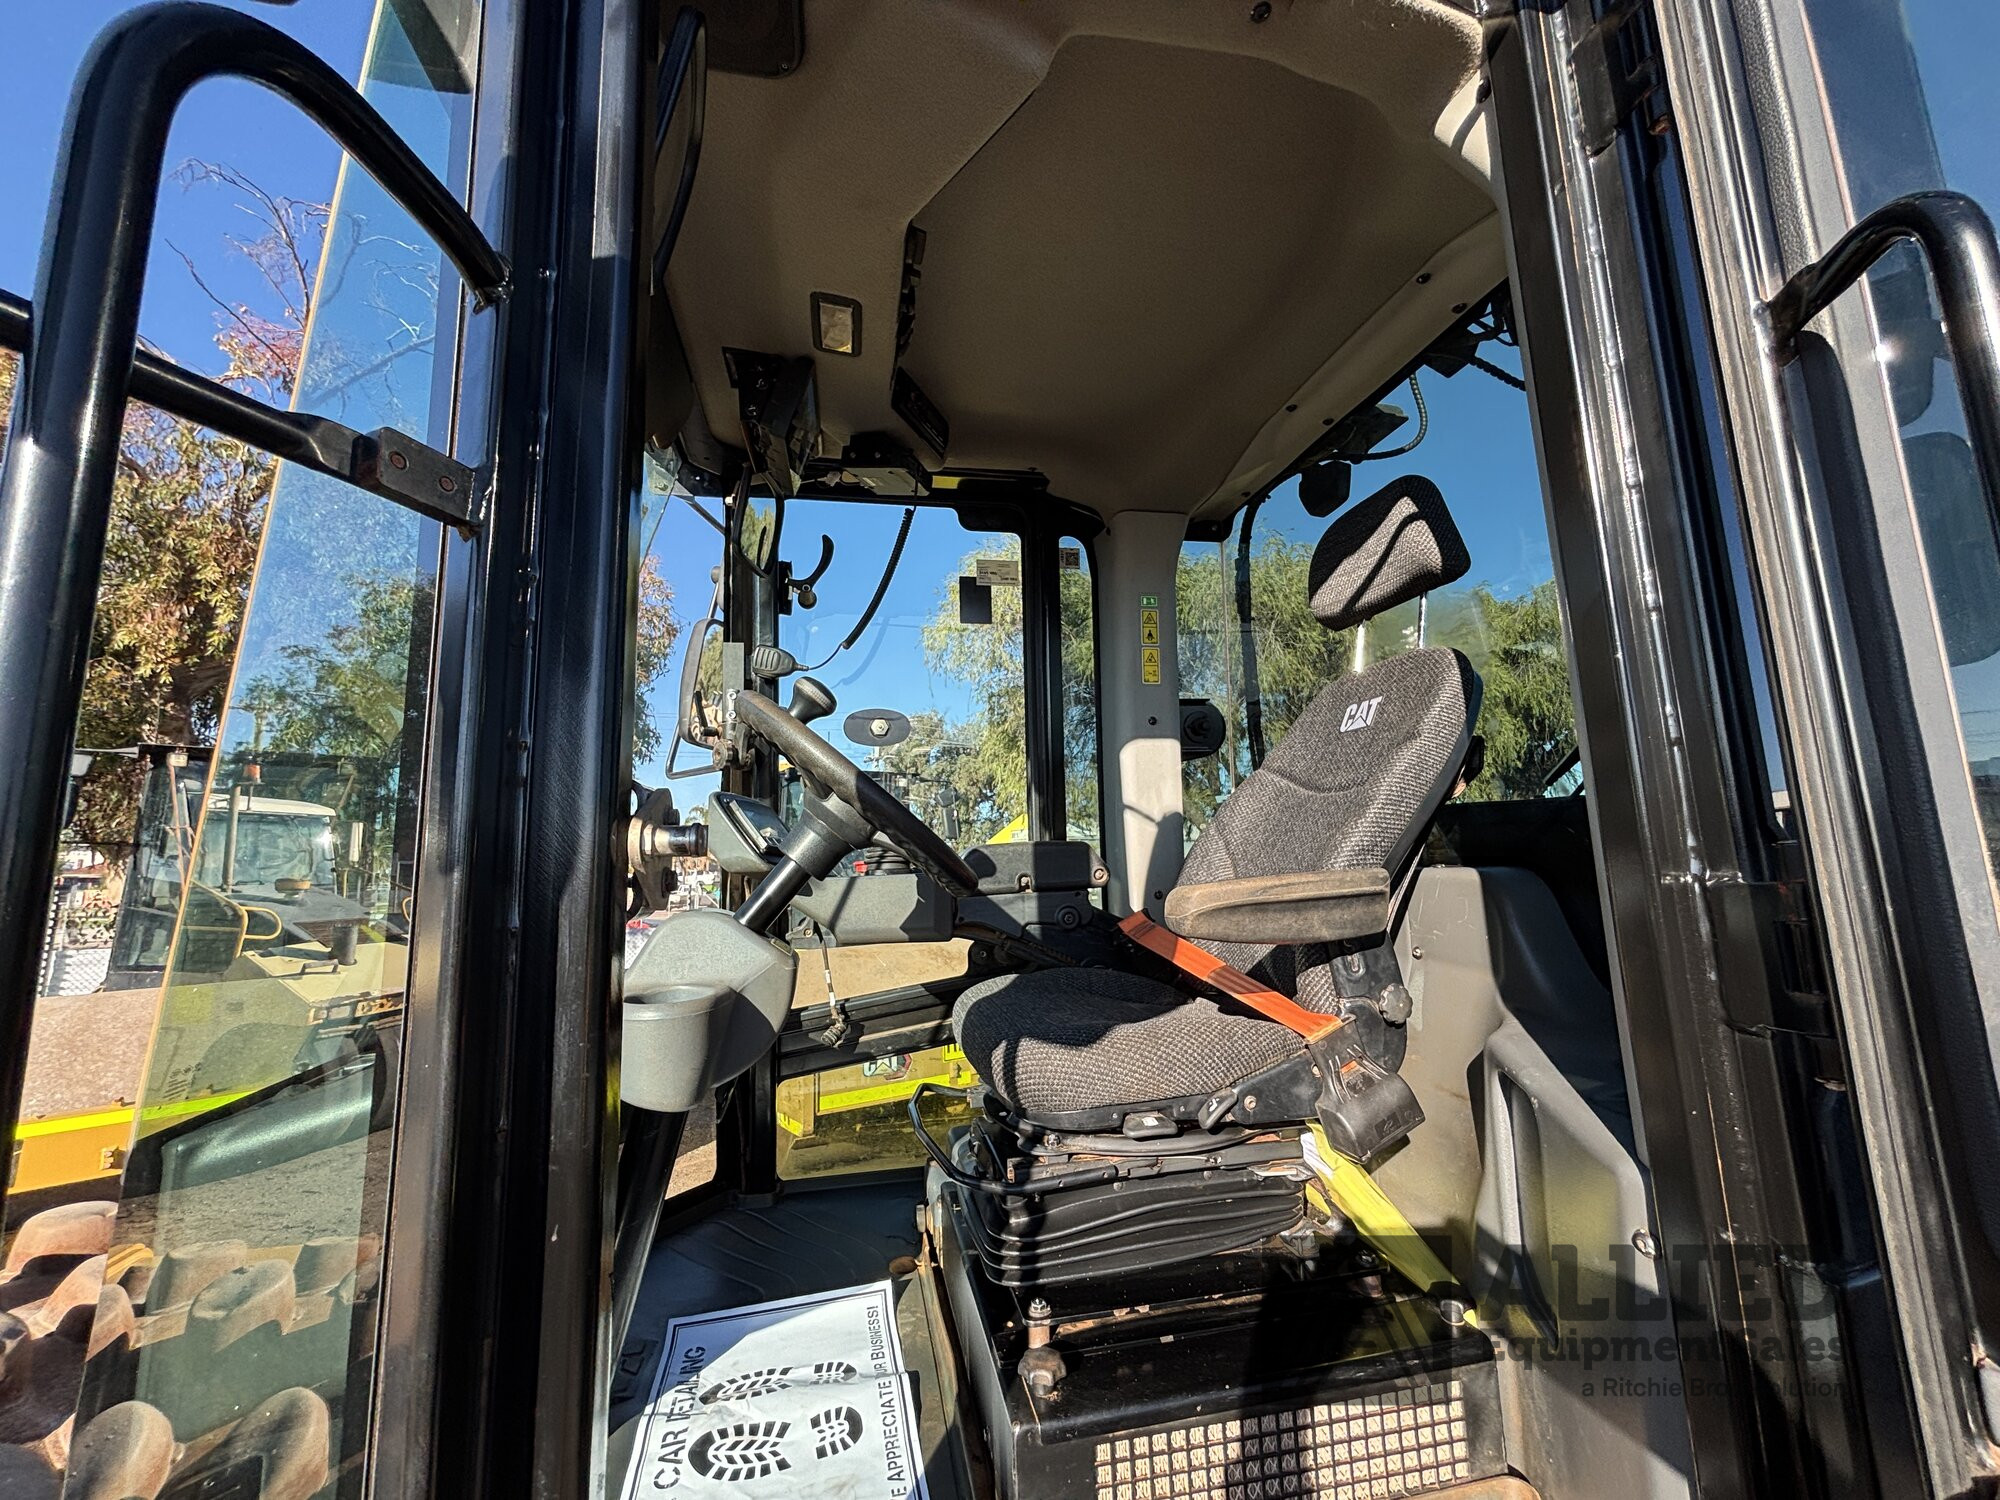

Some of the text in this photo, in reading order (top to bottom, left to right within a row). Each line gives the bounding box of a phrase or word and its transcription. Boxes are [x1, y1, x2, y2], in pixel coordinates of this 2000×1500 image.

[1340, 696, 1383, 733] CAT
[866, 1305, 886, 1361] BUSINESS!
[653, 1426, 689, 1490] CAR
[877, 1380, 906, 1481] APPRECIATE
